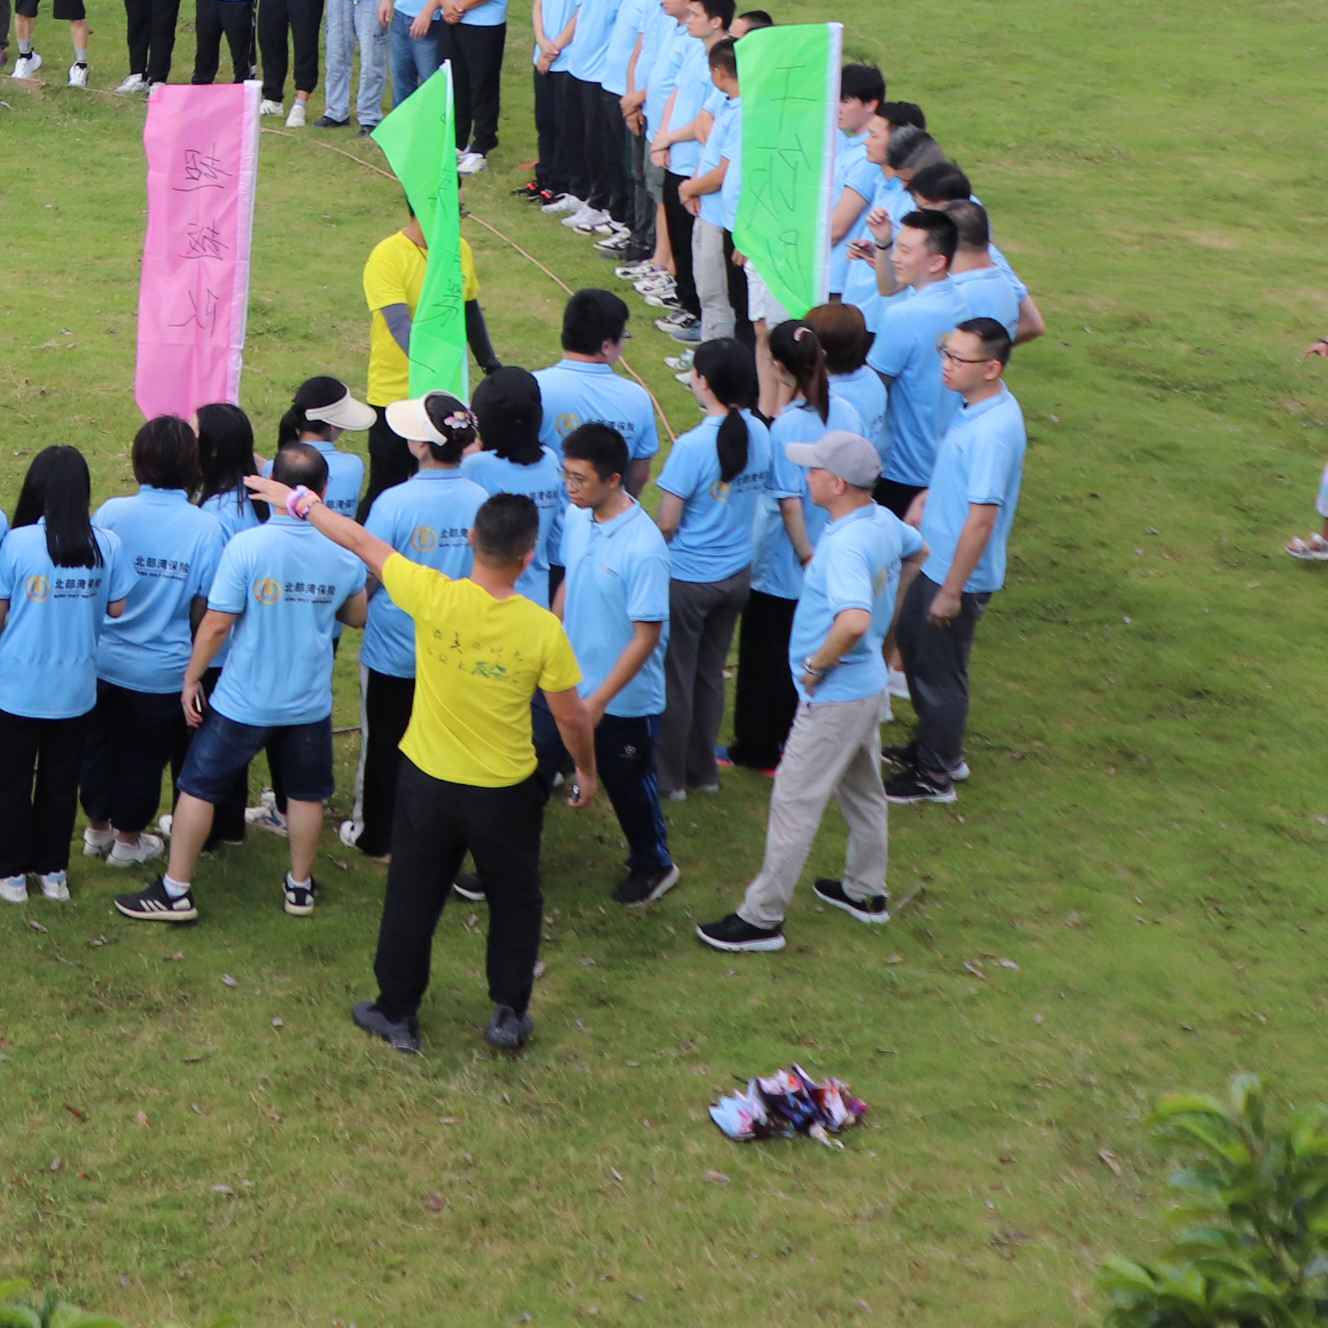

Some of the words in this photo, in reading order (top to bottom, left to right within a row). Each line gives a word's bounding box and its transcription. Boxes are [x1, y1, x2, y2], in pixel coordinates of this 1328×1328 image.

[135, 555, 191, 573] 北部湾保险
[285, 581, 337, 596] 北部湾保险
